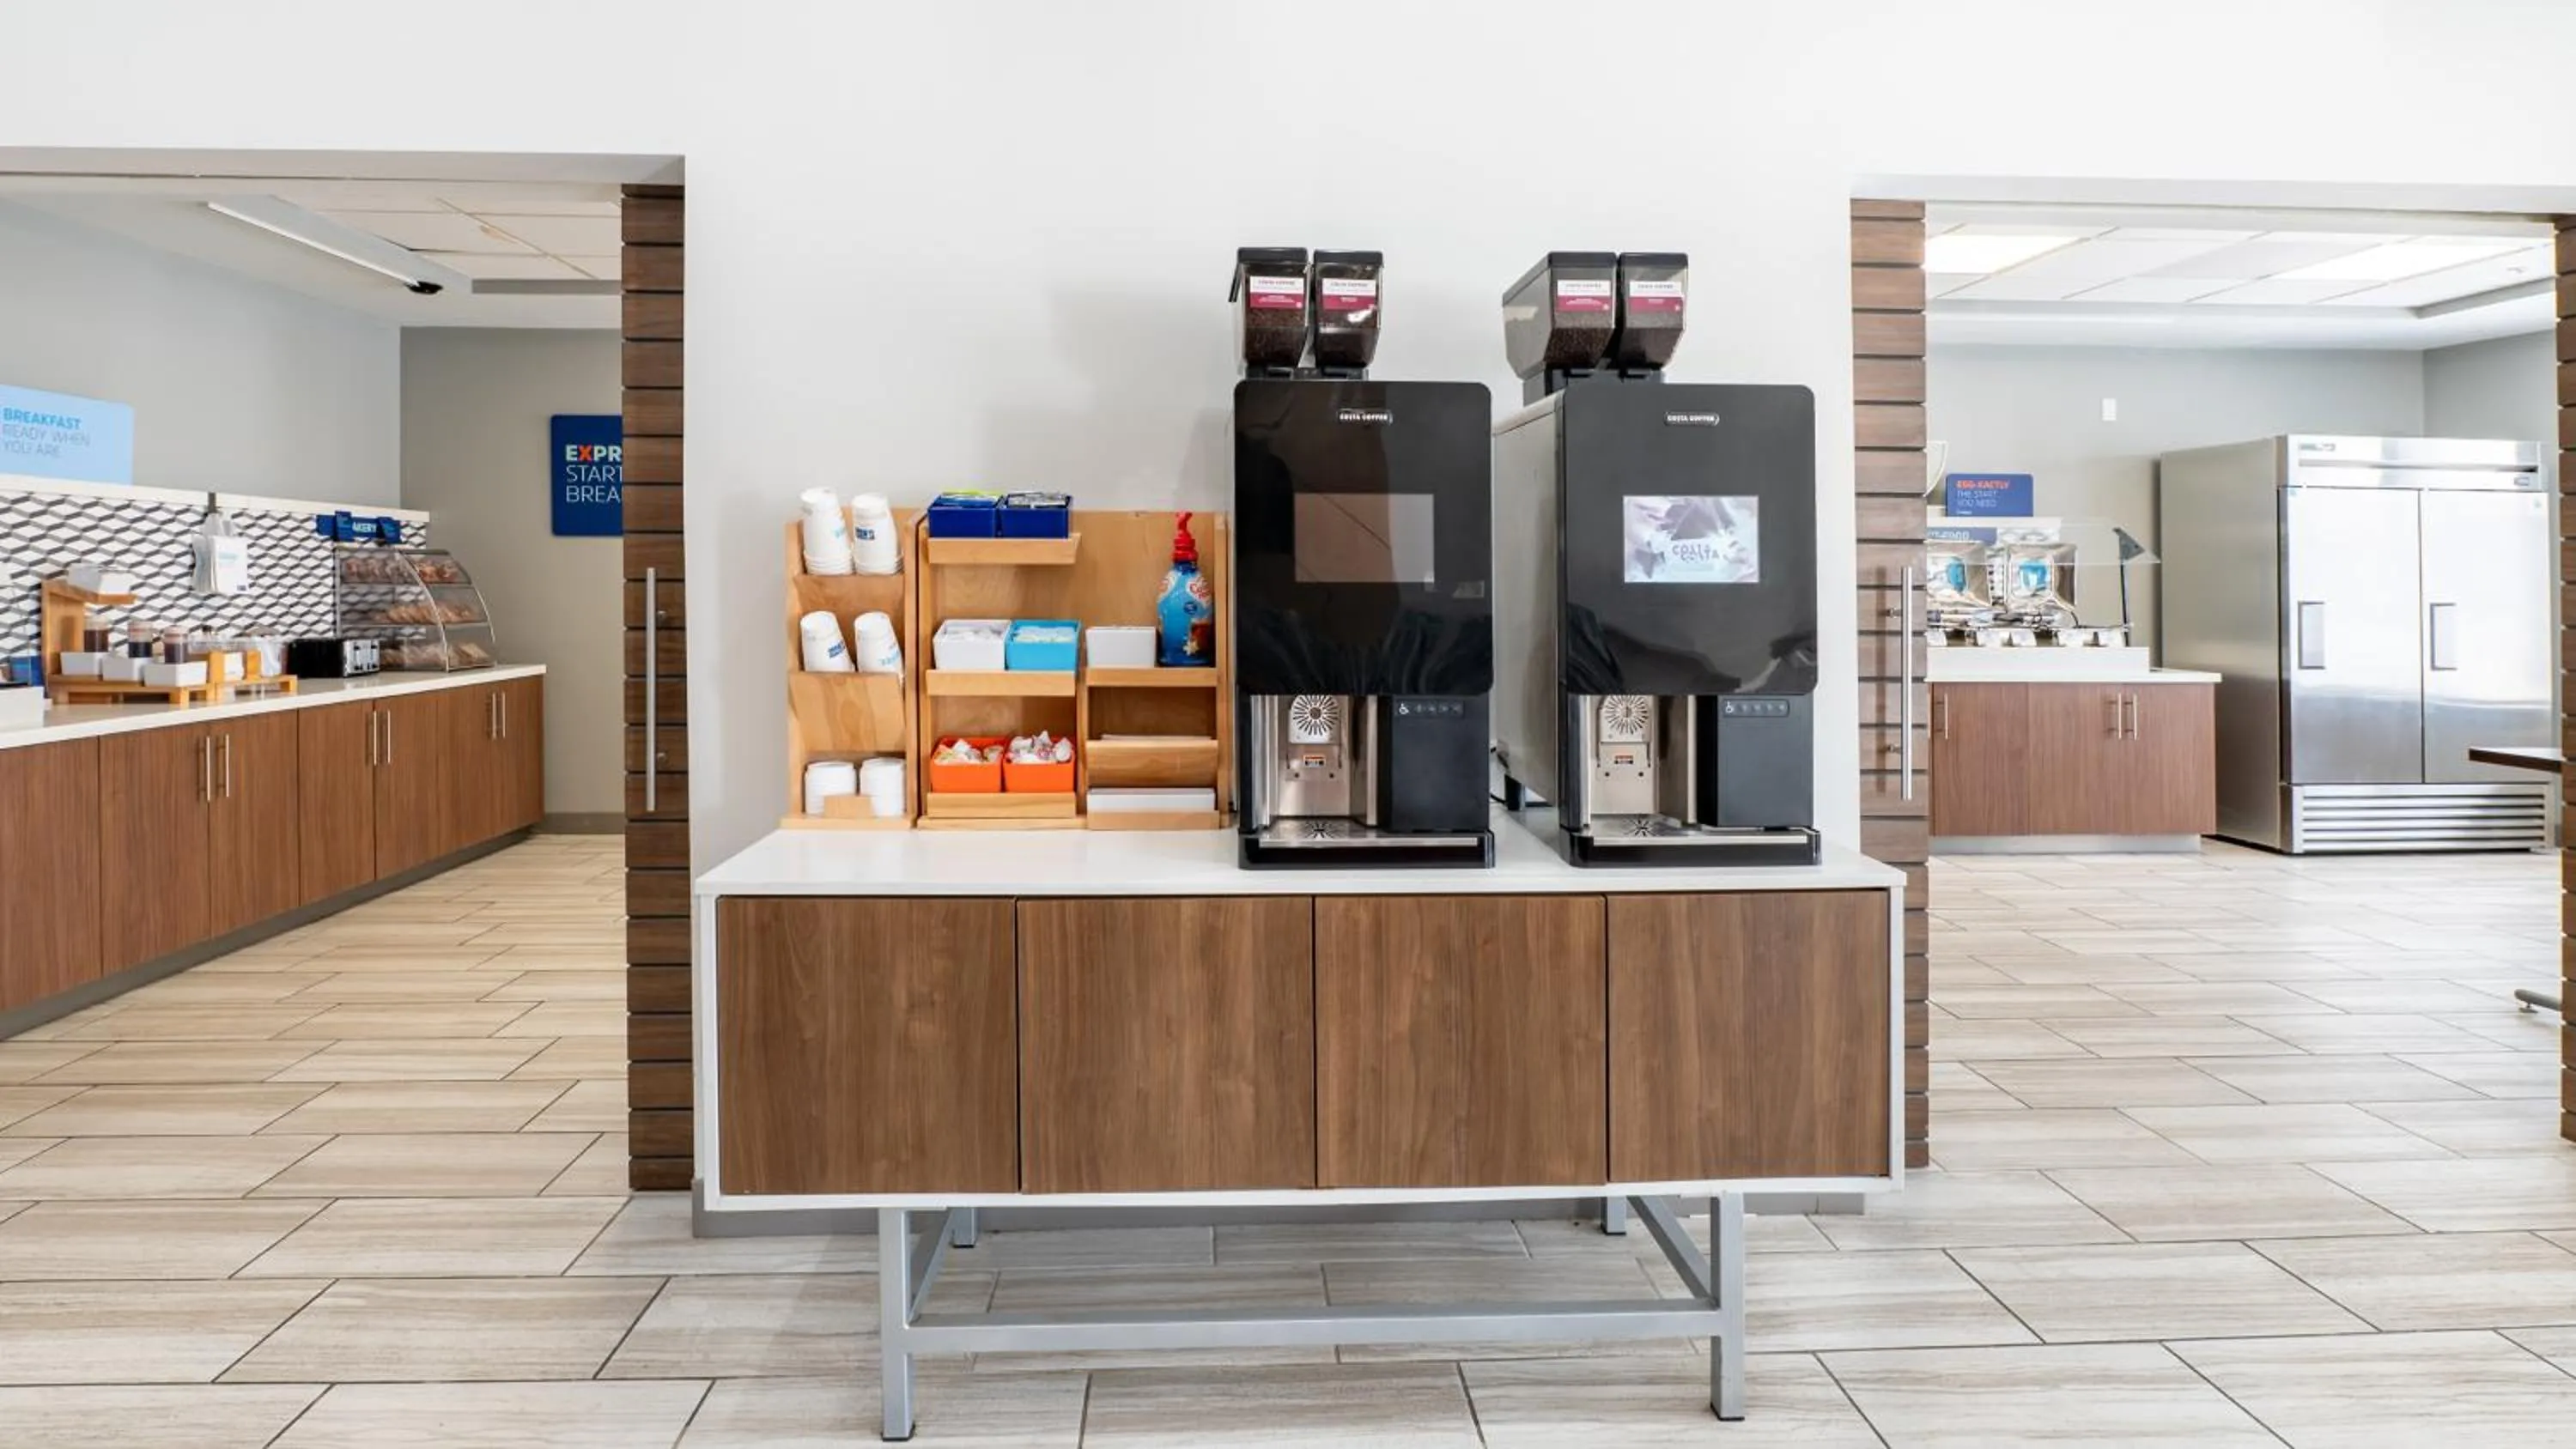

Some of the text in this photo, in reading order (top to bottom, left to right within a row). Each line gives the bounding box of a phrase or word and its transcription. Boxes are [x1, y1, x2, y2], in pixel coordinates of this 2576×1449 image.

[3, 406, 81, 429] BREAKFAST
[3, 424, 47, 440] READY
[3, 440, 31, 453] YOU
[566, 445, 623, 462] EXPR
[566, 486, 621, 503] BREA
